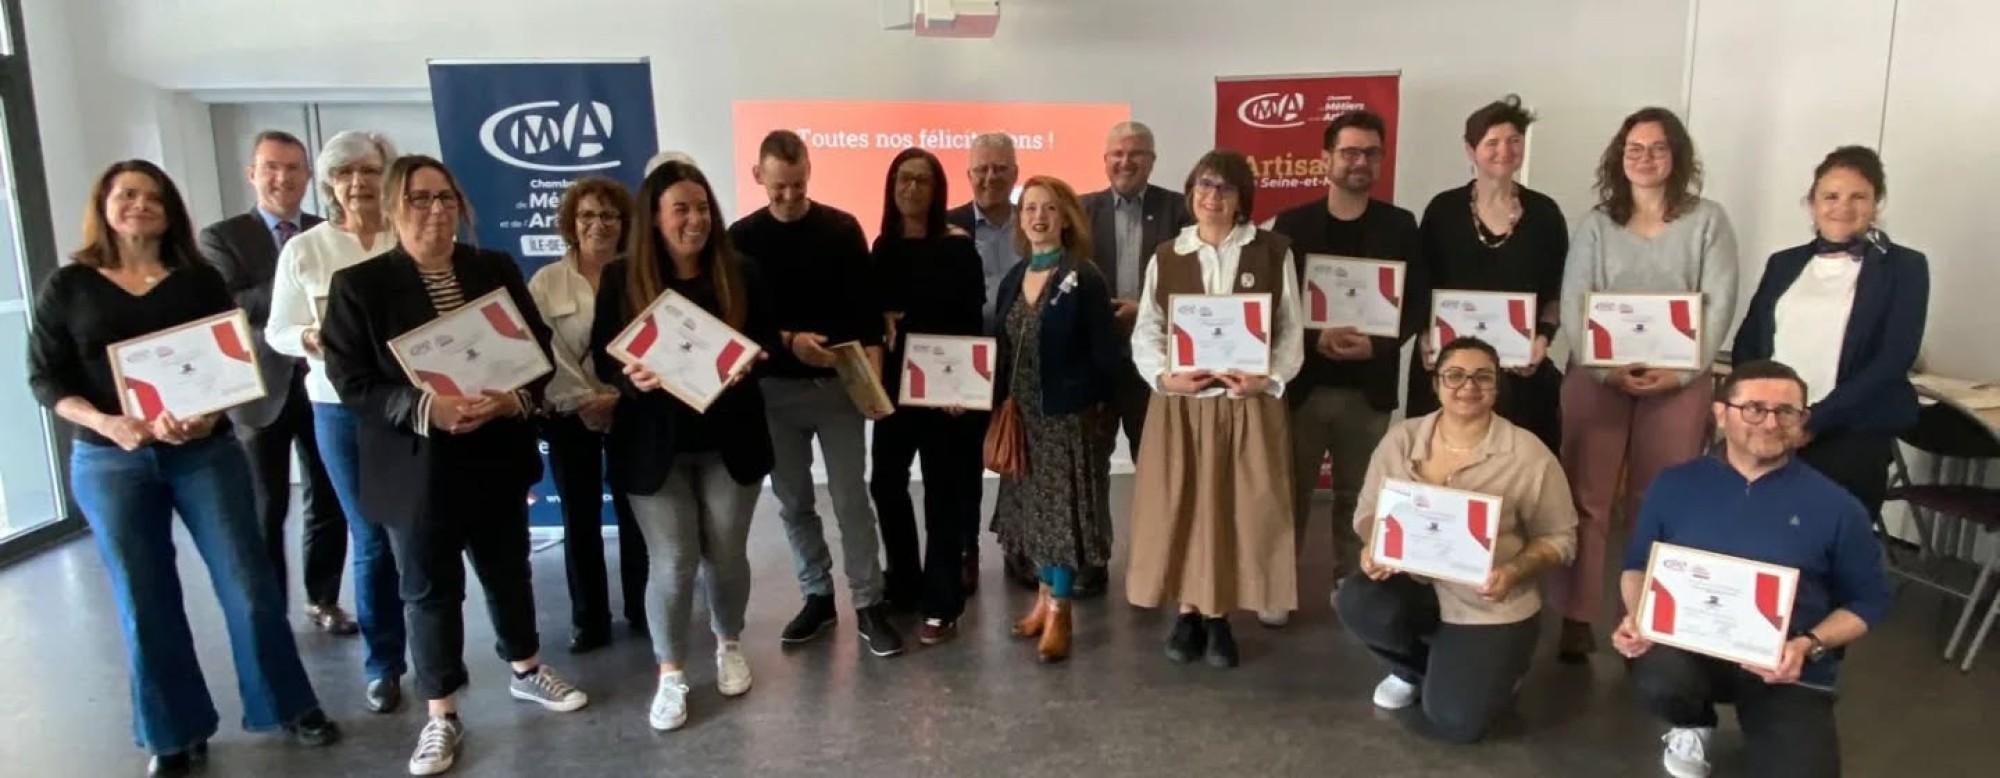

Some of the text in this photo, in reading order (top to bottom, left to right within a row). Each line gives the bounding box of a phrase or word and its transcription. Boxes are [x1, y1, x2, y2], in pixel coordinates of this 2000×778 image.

[1237, 92, 1305, 129] CMA
[479, 100, 621, 171] CMA
[797, 128, 869, 149] Toutes
[876, 132, 913, 149] nos
[919, 127, 1043, 150] félicitons
[1246, 152, 1330, 177] Artisa
